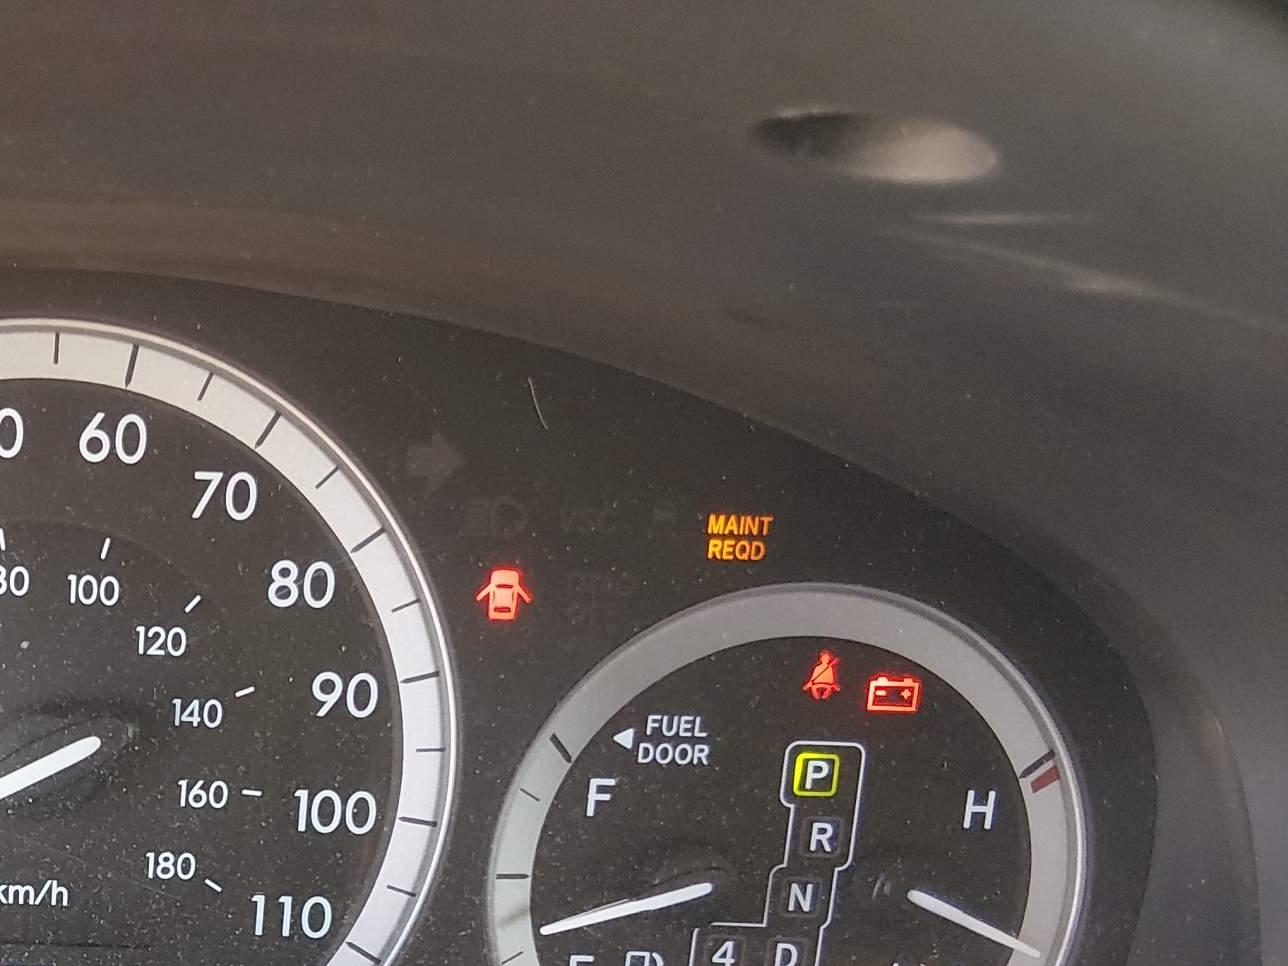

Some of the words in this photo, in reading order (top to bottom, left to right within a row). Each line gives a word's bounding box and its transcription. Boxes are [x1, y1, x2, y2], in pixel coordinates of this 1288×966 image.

[79, 412, 147, 465] 60
[191, 471, 257, 521] 70
[707, 514, 773, 536] MAINT
[707, 538, 765, 561] REQD
[67, 574, 120, 606] 100
[267, 559, 335, 609] 80
[135, 625, 187, 657] 120
[312, 671, 379, 718] 90
[172, 698, 223, 729] 140
[646, 714, 708, 738] FUEL
[637, 742, 710, 765] DOOR
[805, 760, 829, 790] P
[177, 779, 229, 809] 160
[586, 777, 617, 817] F
[963, 789, 996, 830] H
[294, 789, 377, 835] 100
[809, 822, 834, 852] R
[145, 851, 196, 880] 180
[788, 883, 813, 912] N
[251, 894, 332, 939] 110
